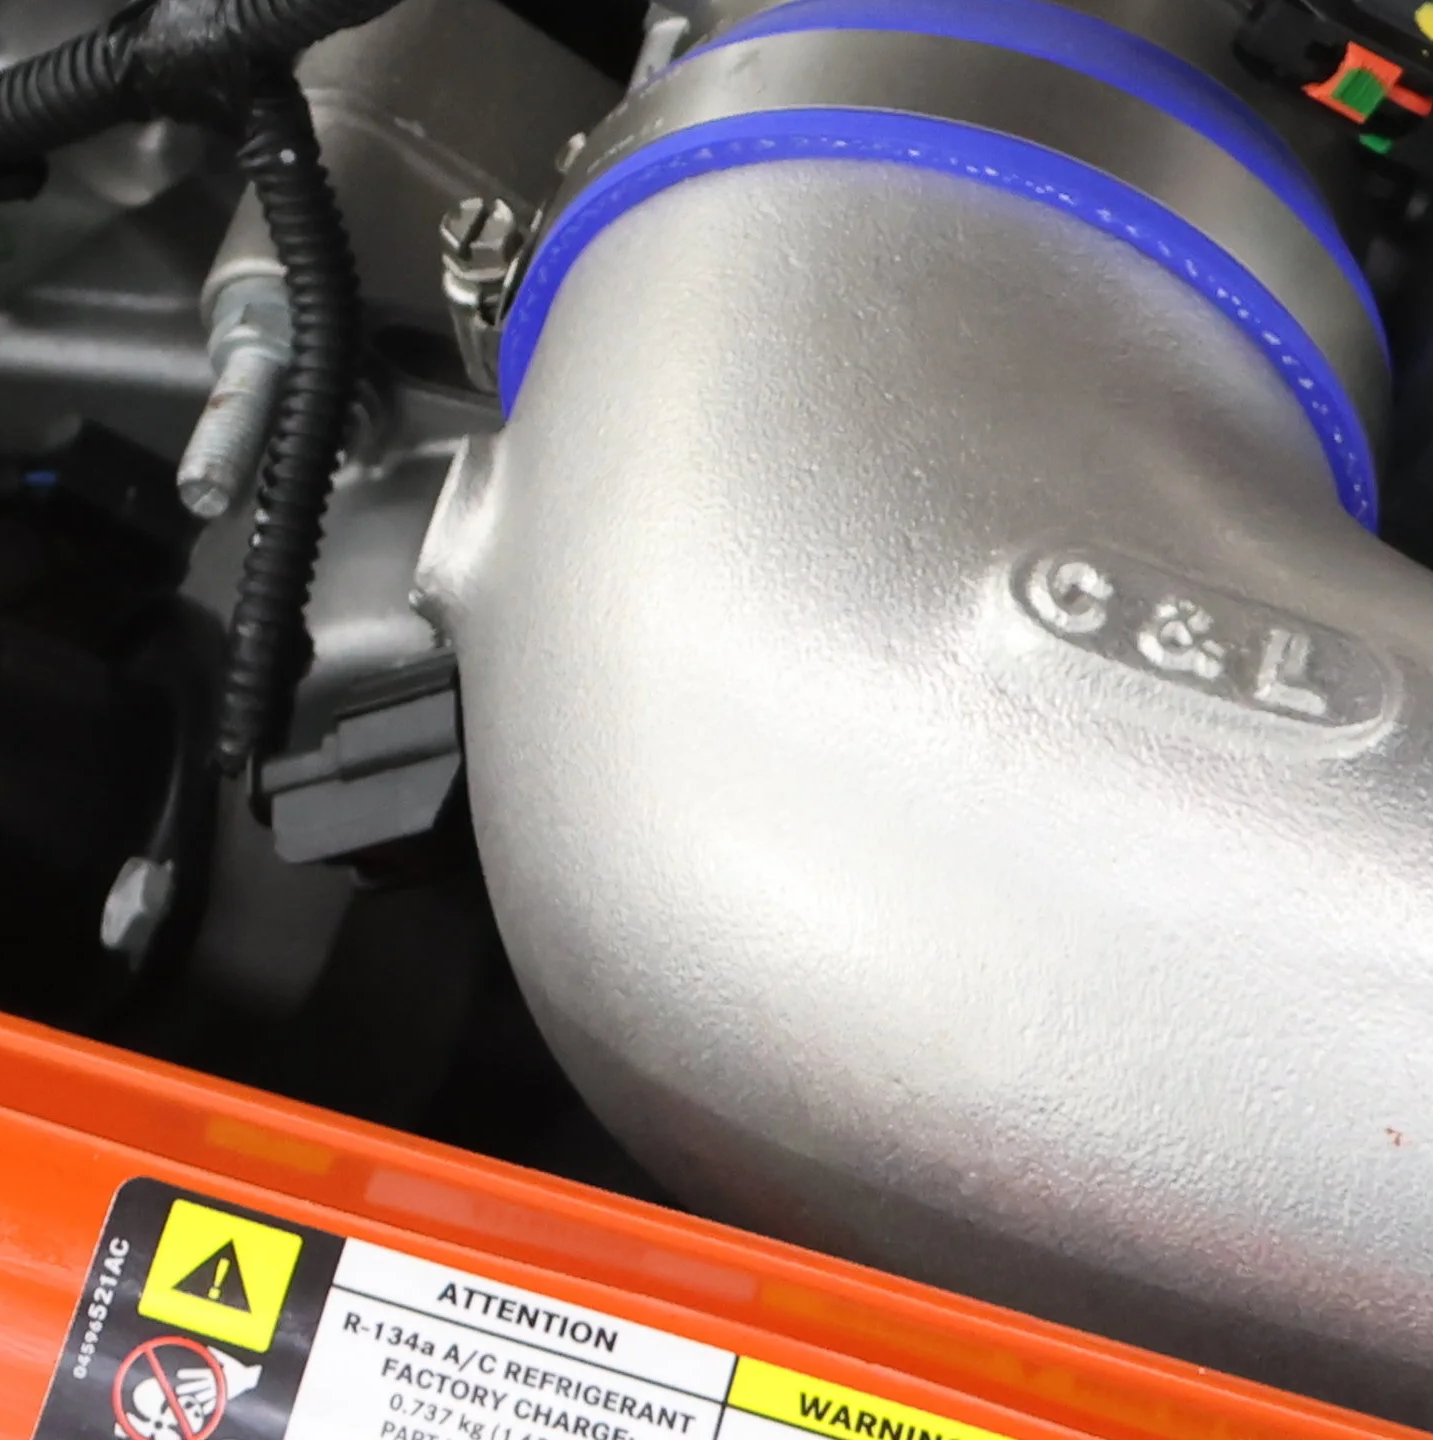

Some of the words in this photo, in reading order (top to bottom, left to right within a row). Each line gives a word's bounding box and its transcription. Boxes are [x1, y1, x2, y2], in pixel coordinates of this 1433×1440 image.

[72, 1236, 130, 1380] 04596521AC
[437, 1281, 620, 1354] ATTENTION
[342, 1311, 437, 1358] R-134a
[442, 1343, 498, 1375] A/C
[503, 1360, 697, 1435] REFRIGERANT
[381, 1357, 509, 1412] FACTORY
[389, 1393, 453, 1425] 0.737
[458, 1412, 485, 1440] kg
[799, 1391, 964, 1440] WARNI
